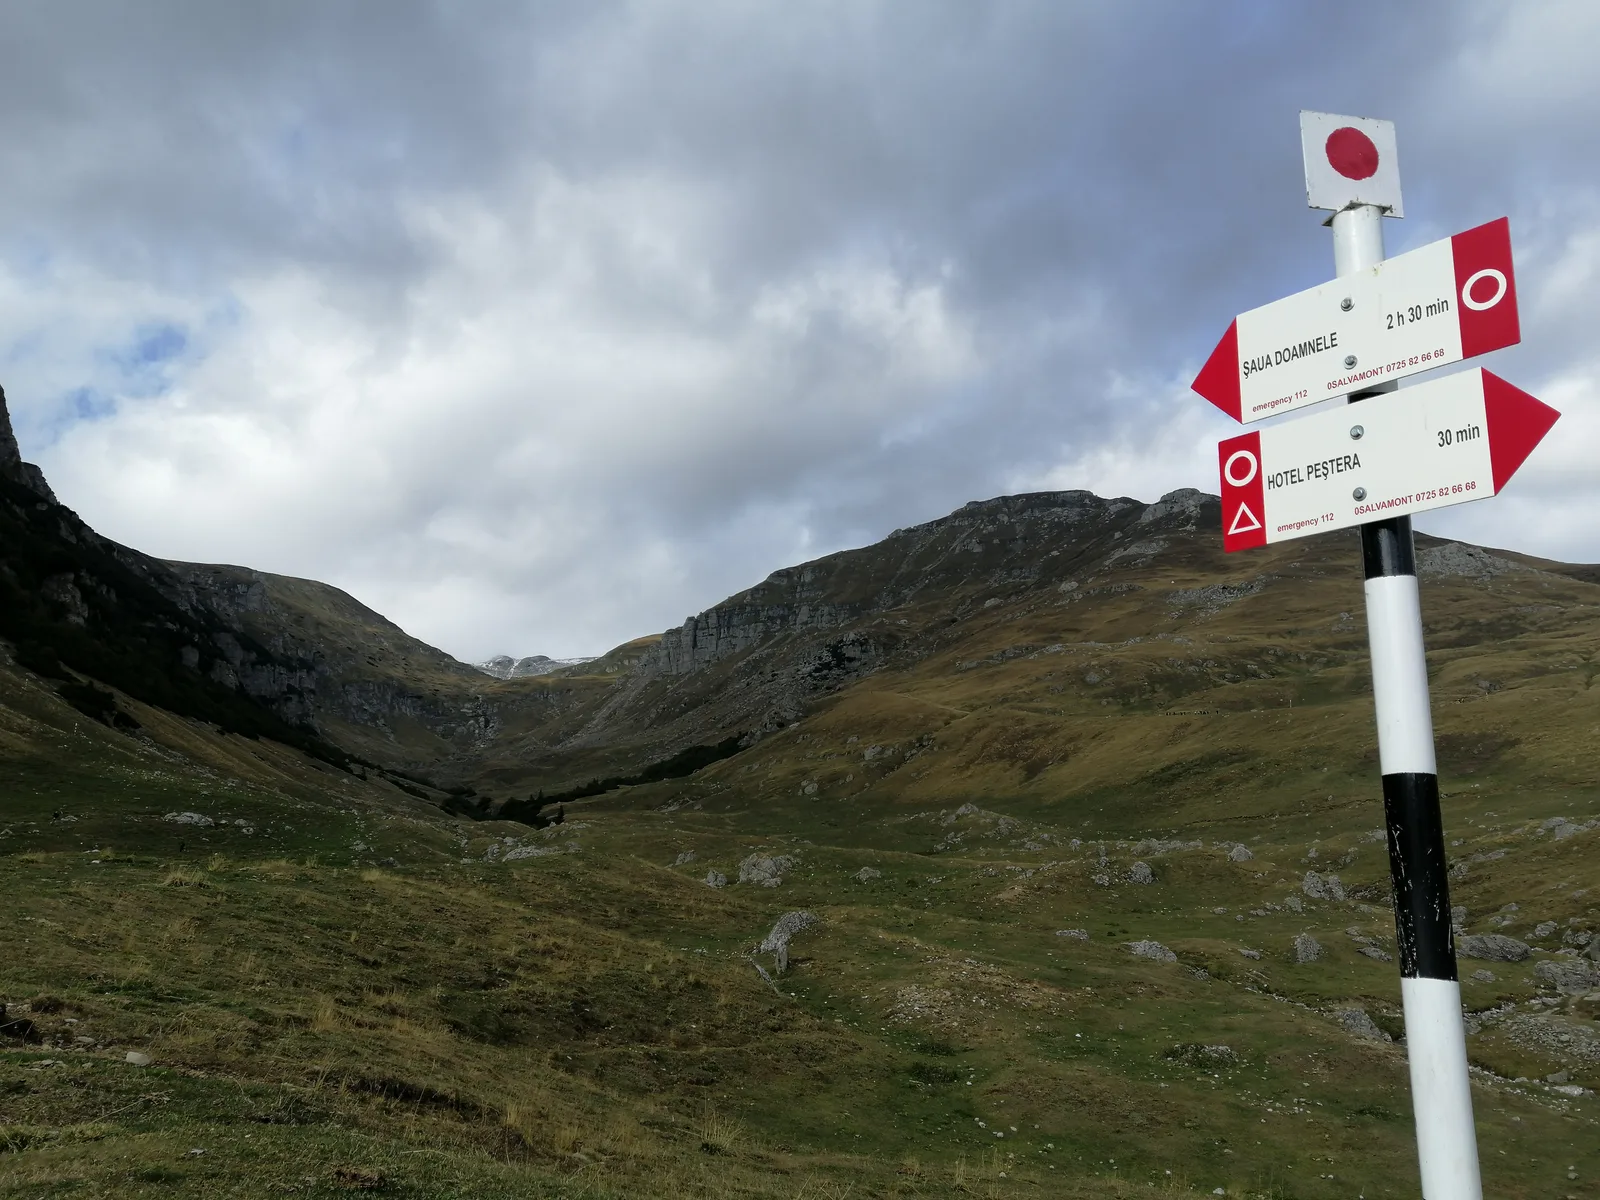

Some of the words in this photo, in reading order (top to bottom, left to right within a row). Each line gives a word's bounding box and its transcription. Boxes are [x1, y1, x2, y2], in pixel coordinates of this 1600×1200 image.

[1387, 314, 1394, 329] 2
[1397, 312, 1405, 326] h
[1408, 304, 1422, 322] 30
[1426, 298, 1449, 317] min
[1275, 332, 1338, 366] DOAMNELE
[1386, 360, 1407, 373] 0725
[1408, 356, 1419, 367] 82
[1421, 351, 1432, 362] 66
[1433, 348, 1445, 359] 68
[1252, 394, 1293, 413] emergency
[1294, 390, 1308, 400] 112
[1438, 429, 1452, 448] 30
[1456, 424, 1480, 443] min
[1268, 468, 1304, 490] HOTEL
[1416, 489, 1437, 502] 0725
[1438, 486, 1450, 497] 82
[1452, 483, 1463, 494] 66
[1465, 481, 1476, 491] 68
[1277, 517, 1319, 533] emergency
[1320, 513, 1334, 523] 112
